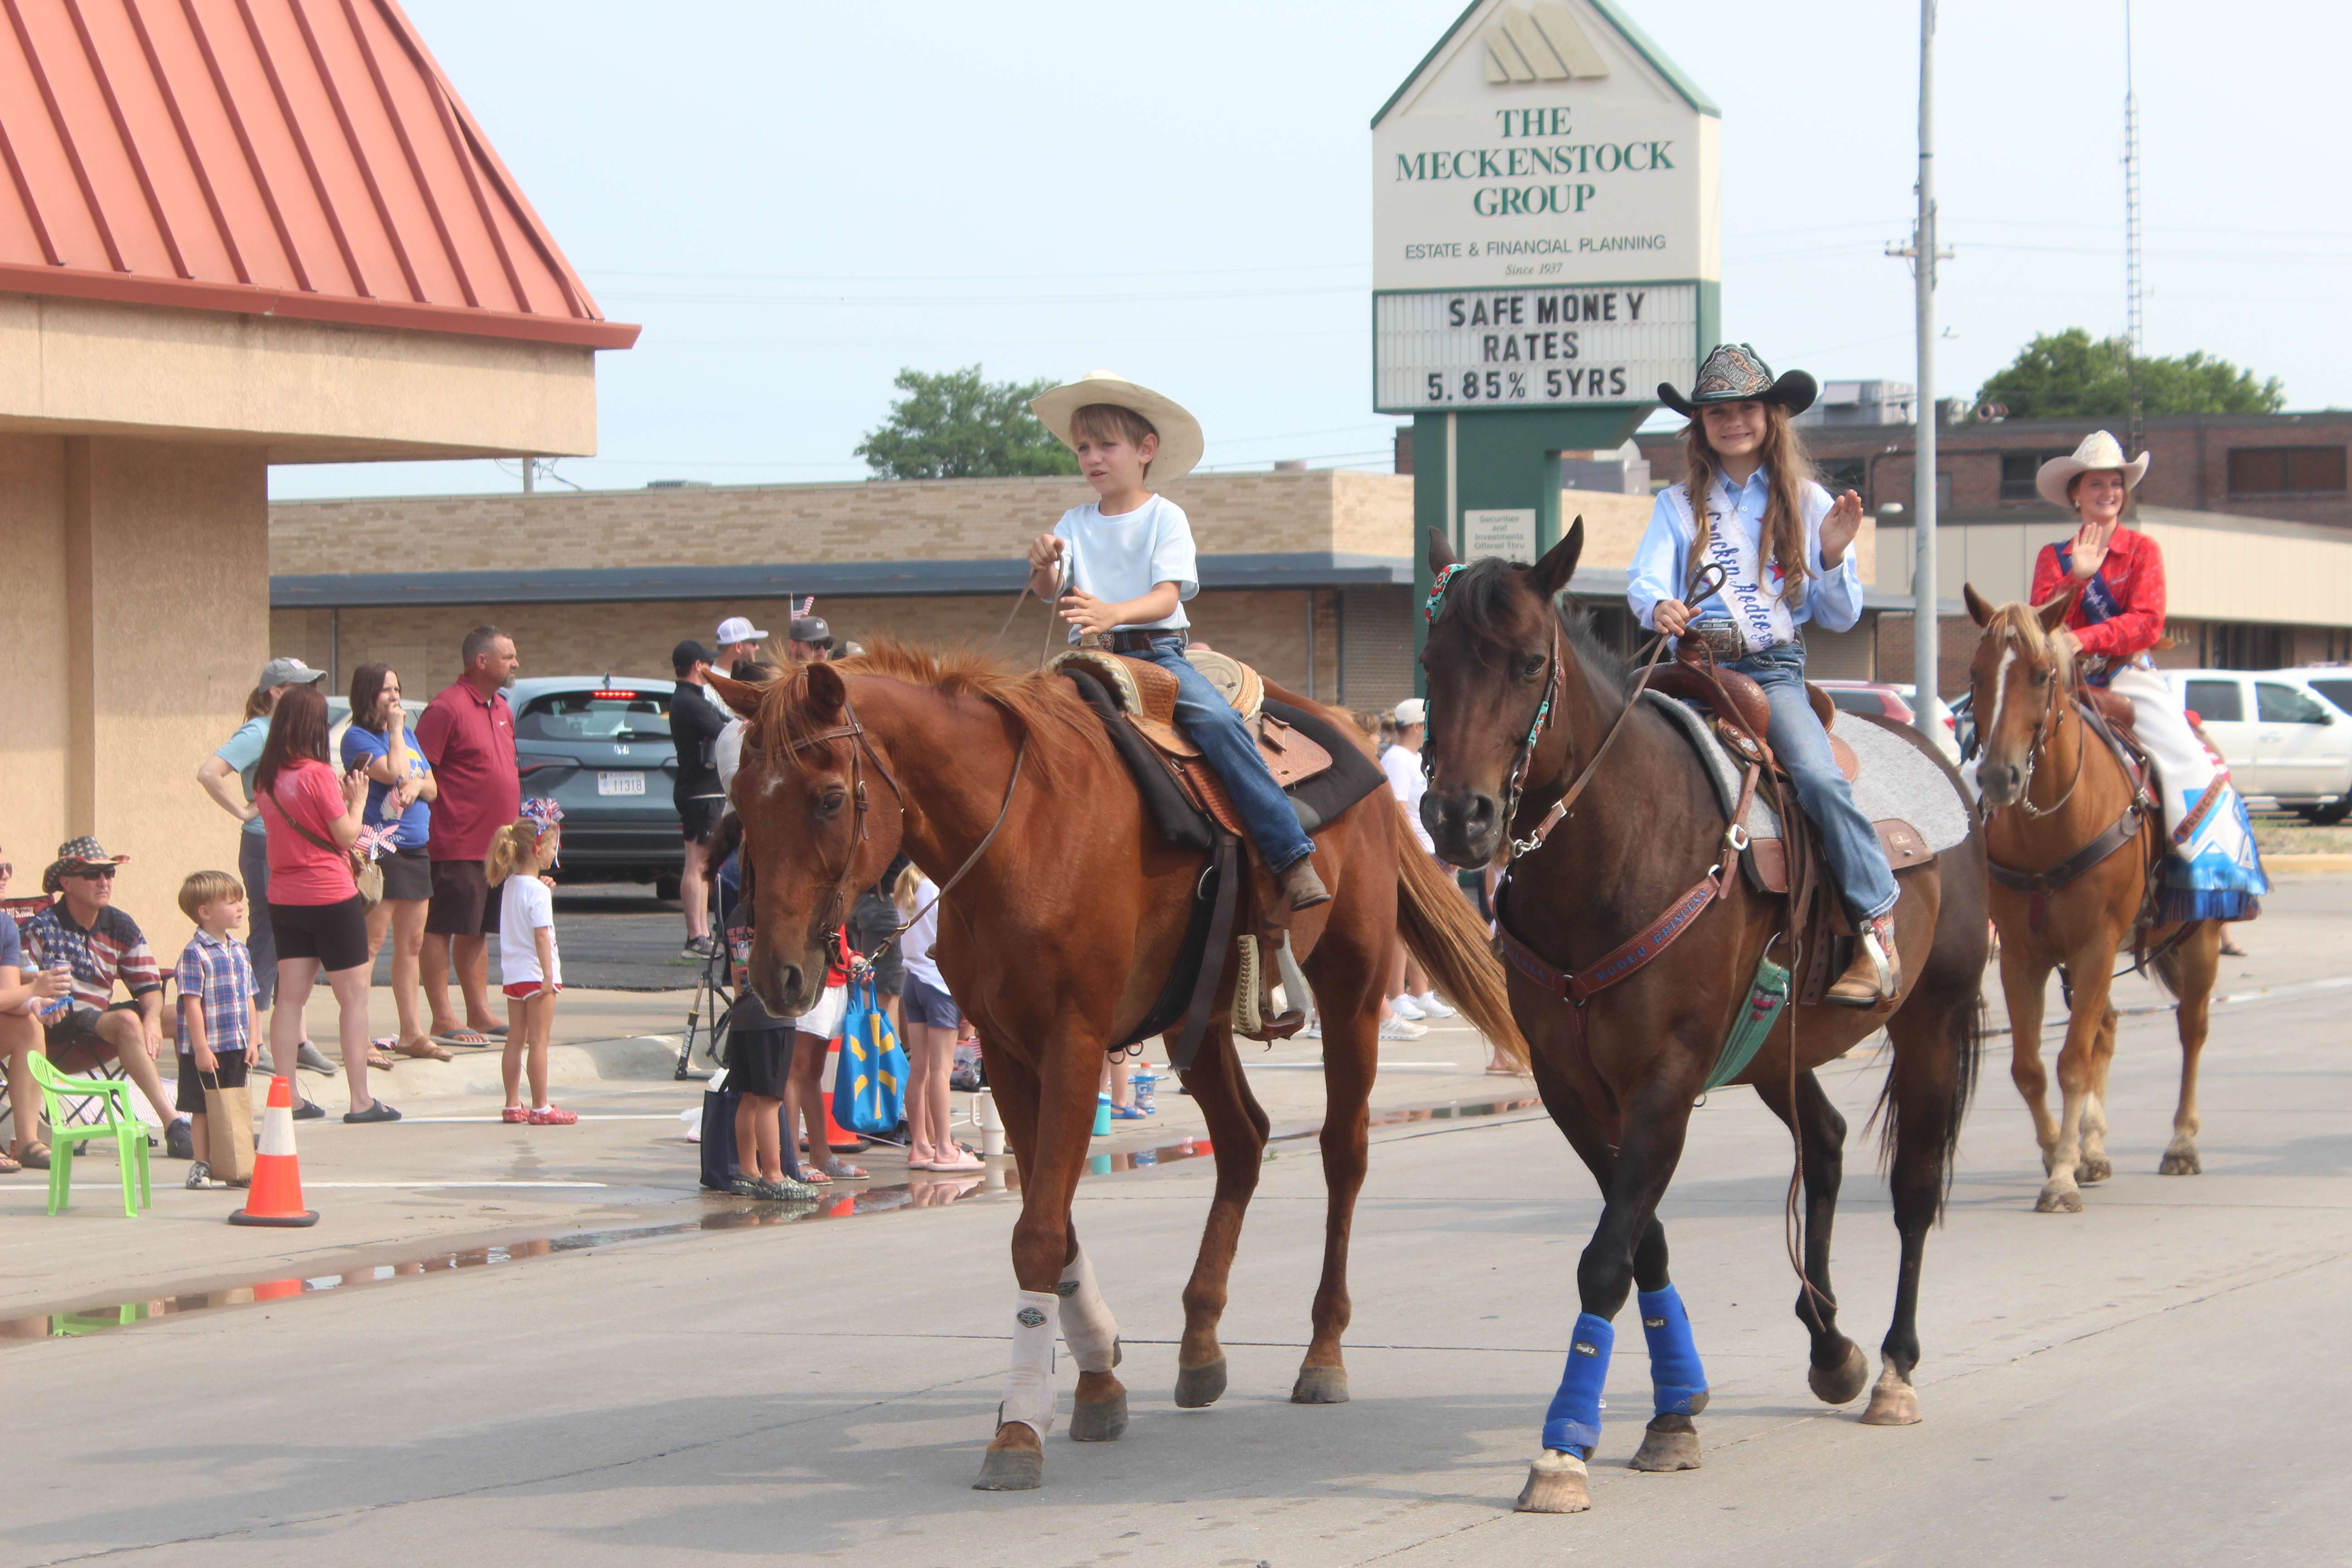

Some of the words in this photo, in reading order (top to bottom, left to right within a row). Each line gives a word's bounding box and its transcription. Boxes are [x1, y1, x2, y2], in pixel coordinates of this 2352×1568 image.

[1497, 107, 1572, 138] THE
[1396, 140, 1675, 181] MECKENSTOCK
[1474, 184, 1596, 216] GROUP
[1405, 243, 1462, 260] ESTATE
[1469, 242, 1480, 257] &
[1487, 238, 1573, 256] FINANCIAL
[1579, 235, 1666, 253] PLANNING
[1505, 264, 1534, 276] Since
[1539, 262, 1563, 274] 1937
[1450, 297, 1524, 327] SAFE
[1538, 293, 1645, 324] MONEY
[1484, 332, 1579, 362] RATES
[1428, 372, 1525, 401] 5.85%
[1547, 367, 1627, 398] 5YRS
[1728, 583, 1771, 633] Rodeo
[1597, 946, 1647, 981] RODEO
[1652, 889, 1708, 945] PRINCESS
